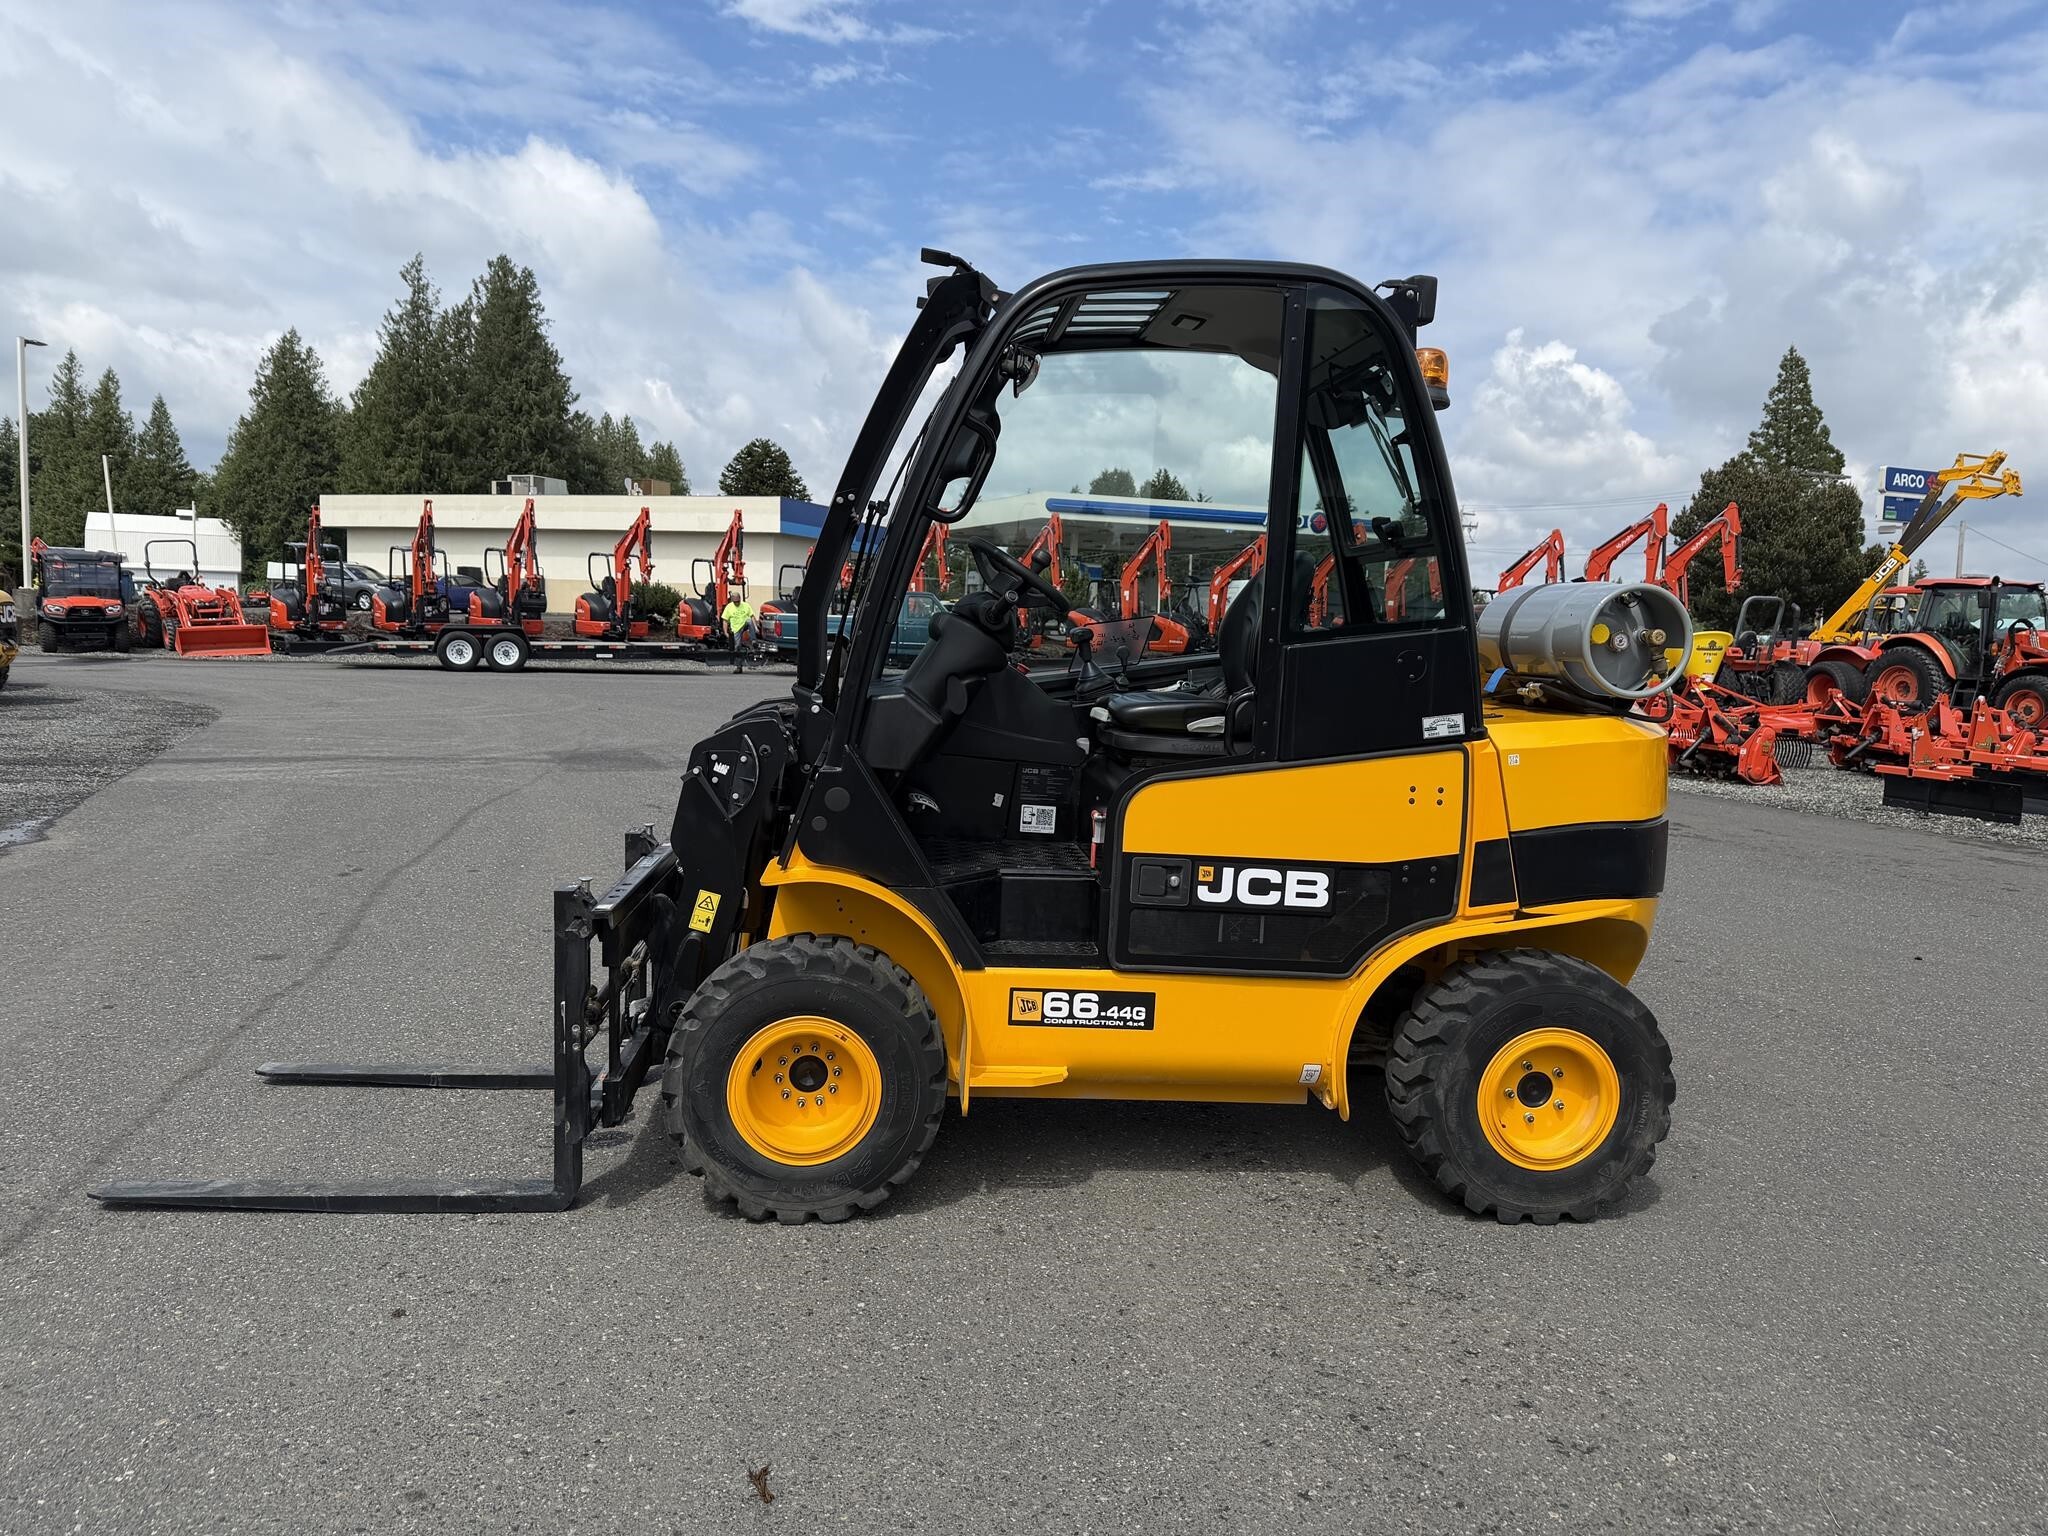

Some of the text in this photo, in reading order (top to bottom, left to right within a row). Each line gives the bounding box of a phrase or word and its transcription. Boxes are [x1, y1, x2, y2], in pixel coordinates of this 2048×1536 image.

[1892, 472, 1925, 489] ARCO
[1875, 557, 1898, 583] JCB
[1197, 867, 1330, 908] JCB
[1019, 998, 1037, 1013] JCB
[1043, 1017, 1124, 1027] CONSTRUCTION
